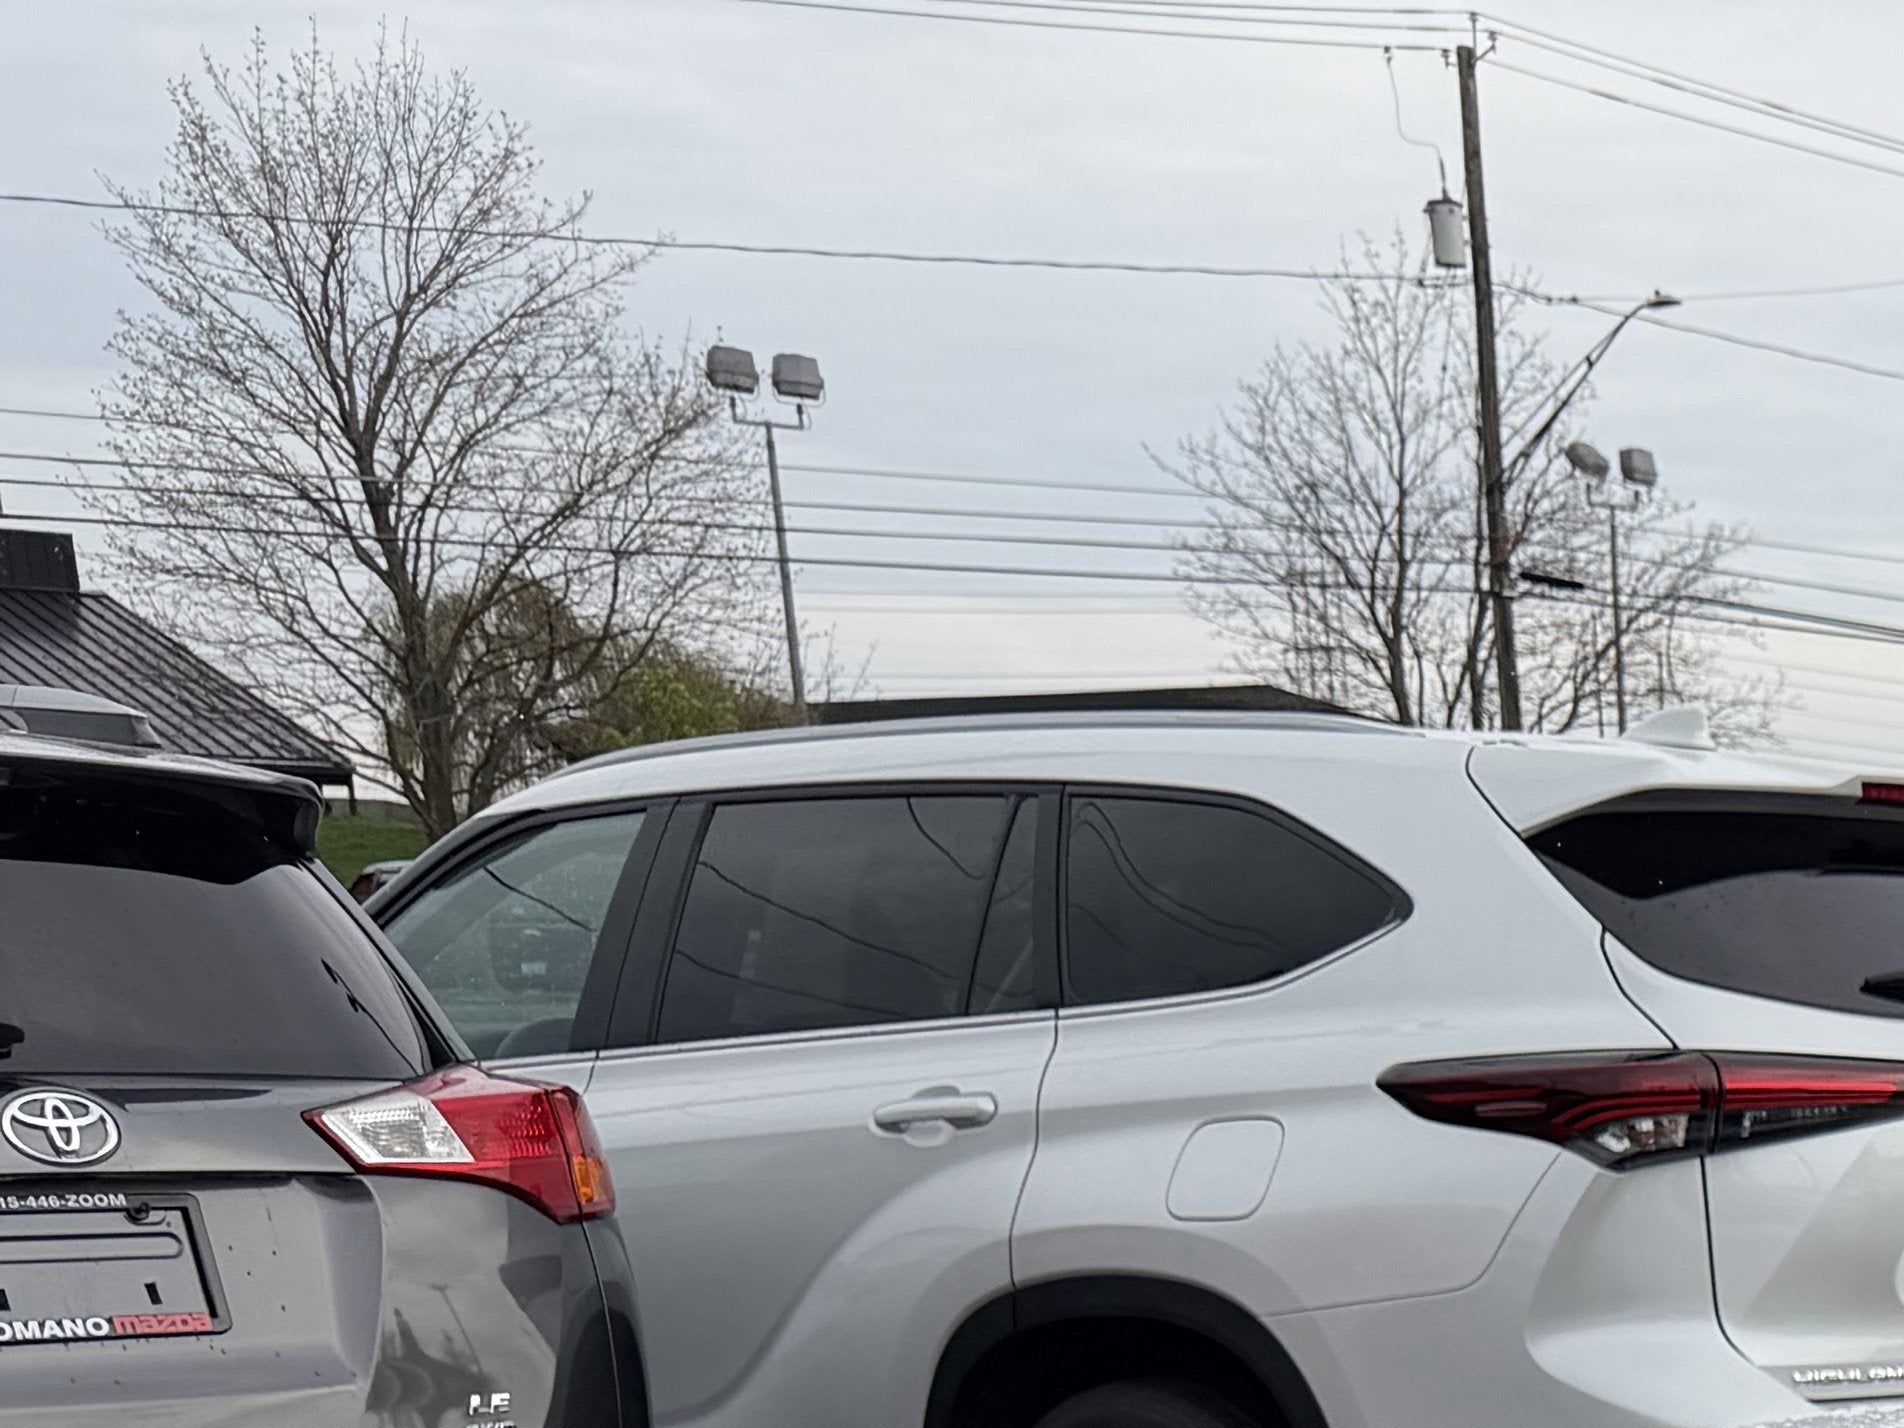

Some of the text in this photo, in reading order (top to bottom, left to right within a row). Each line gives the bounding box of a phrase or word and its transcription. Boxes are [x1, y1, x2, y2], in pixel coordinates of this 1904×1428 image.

[0, 1193, 128, 1210] 15-446-ZOOM
[0, 1317, 110, 1342] OMANO
[469, 1392, 511, 1416] LE
